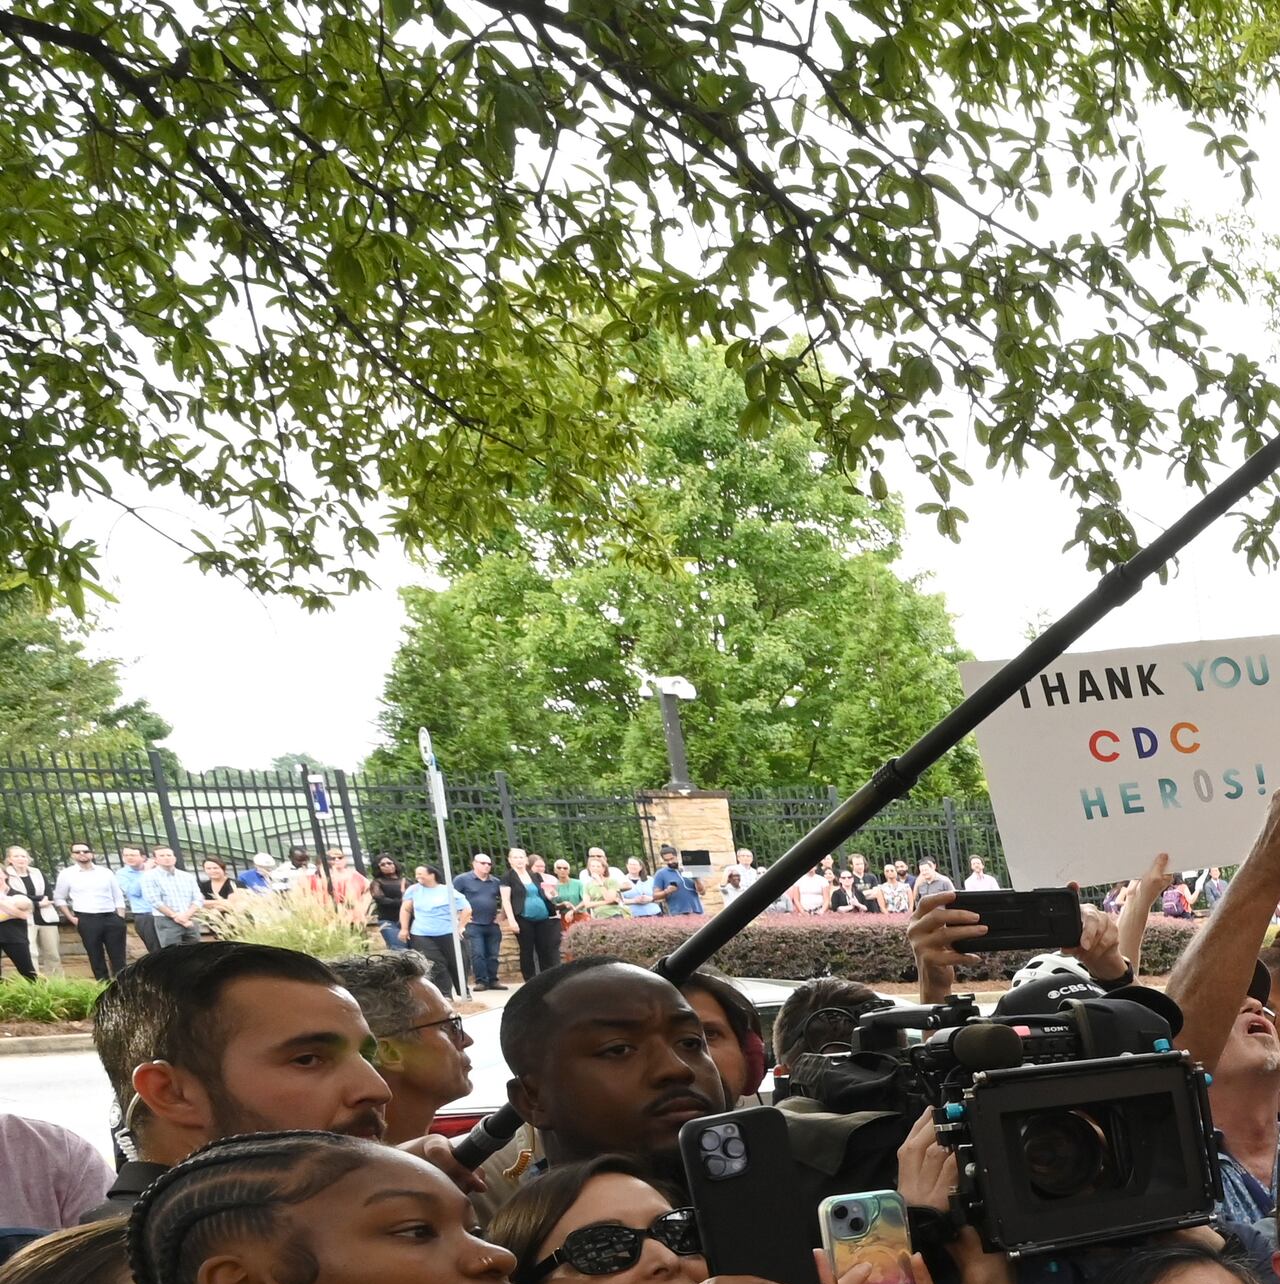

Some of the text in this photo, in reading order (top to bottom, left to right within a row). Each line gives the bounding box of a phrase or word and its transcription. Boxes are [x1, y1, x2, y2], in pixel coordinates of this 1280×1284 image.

[1184, 654, 1270, 692] YOU
[1088, 722, 1201, 763] CDC
[1080, 764, 1266, 820] HEROS!
[1059, 983, 1088, 995] CBS
[1043, 1025, 1070, 1033] SONY
